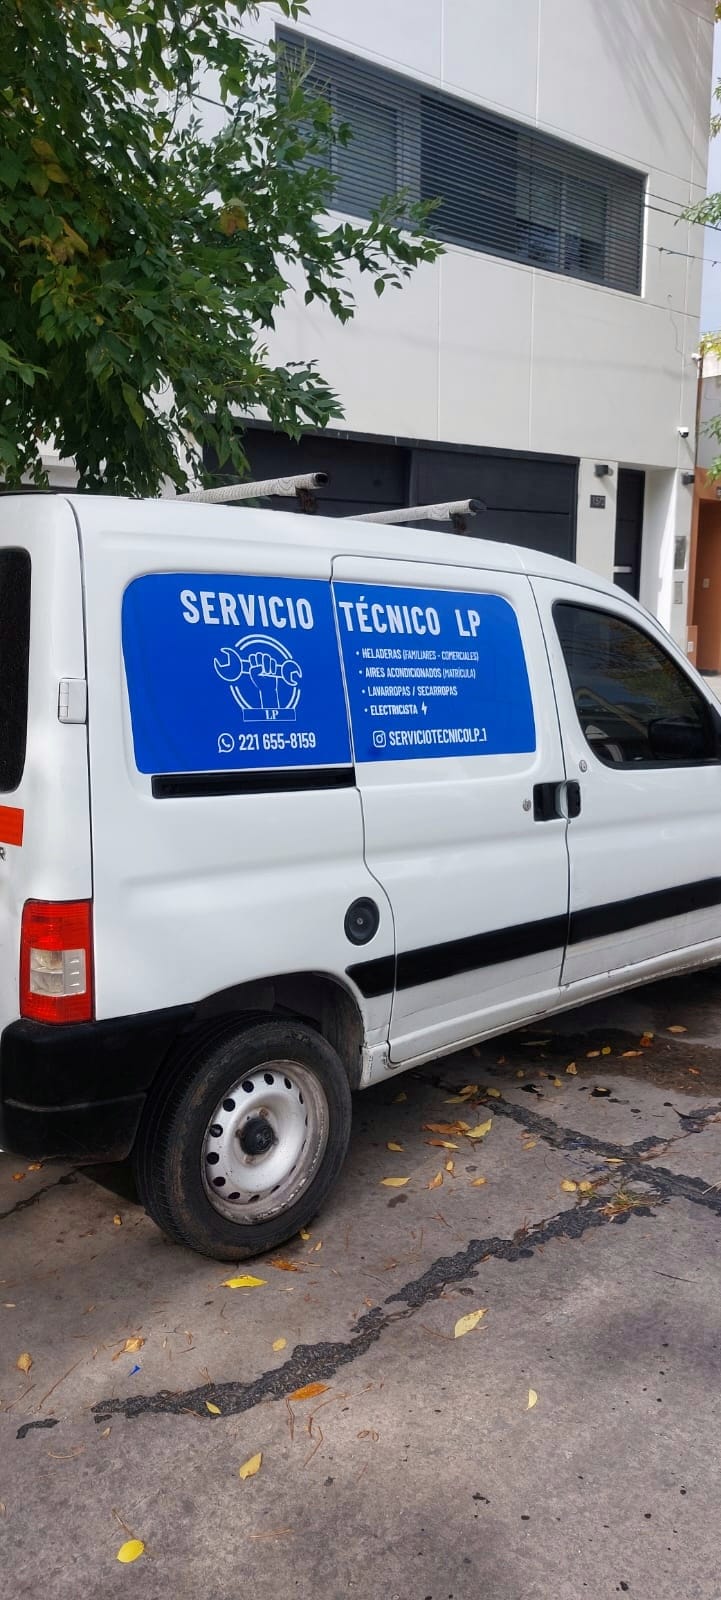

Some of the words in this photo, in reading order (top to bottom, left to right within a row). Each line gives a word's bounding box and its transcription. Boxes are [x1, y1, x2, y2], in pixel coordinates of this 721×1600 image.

[180, 589, 314, 630] SERVICIO
[338, 596, 441, 636] TÉCNICO
[455, 609, 481, 637] LP
[361, 648, 402, 659] HELADERAS
[402, 649, 436, 661] (FAMILIARES
[441, 651, 479, 663] COMERCIALES)
[365, 667, 386, 678] AIRES
[386, 667, 442, 679] ACONDICIONADOS
[367, 686, 411, 697] LAVARROPAS
[417, 685, 458, 697] SECARROPAS
[265, 709, 279, 720] LP
[370, 704, 418, 716] ELECTRICISTA
[238, 733, 260, 751] 221
[262, 732, 316, 750] 655-8159
[388, 727, 488, 746] SERVICIOTECNICOLP_1
